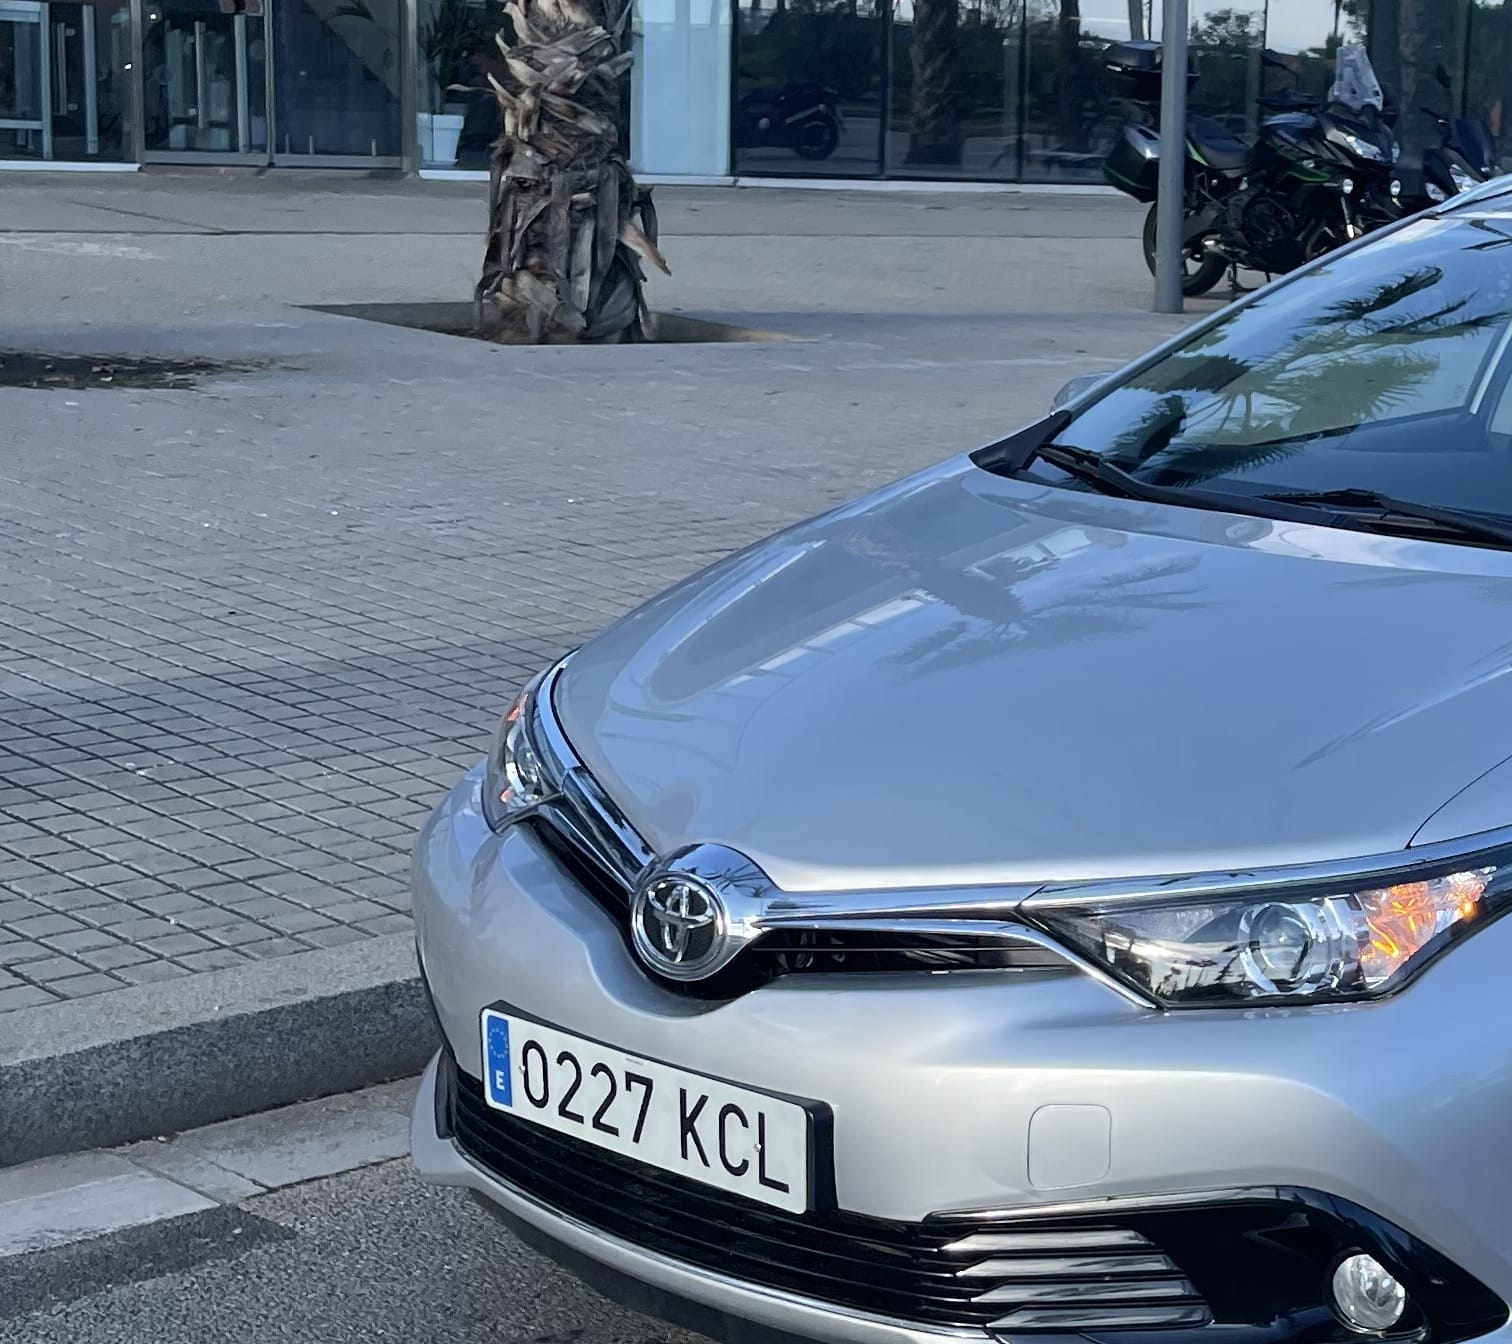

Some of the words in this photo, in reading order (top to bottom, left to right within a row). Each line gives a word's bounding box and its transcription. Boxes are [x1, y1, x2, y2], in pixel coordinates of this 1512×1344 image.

[494, 1069, 506, 1092] E
[521, 1039, 654, 1144] 0227
[679, 1087, 790, 1194] KCL
